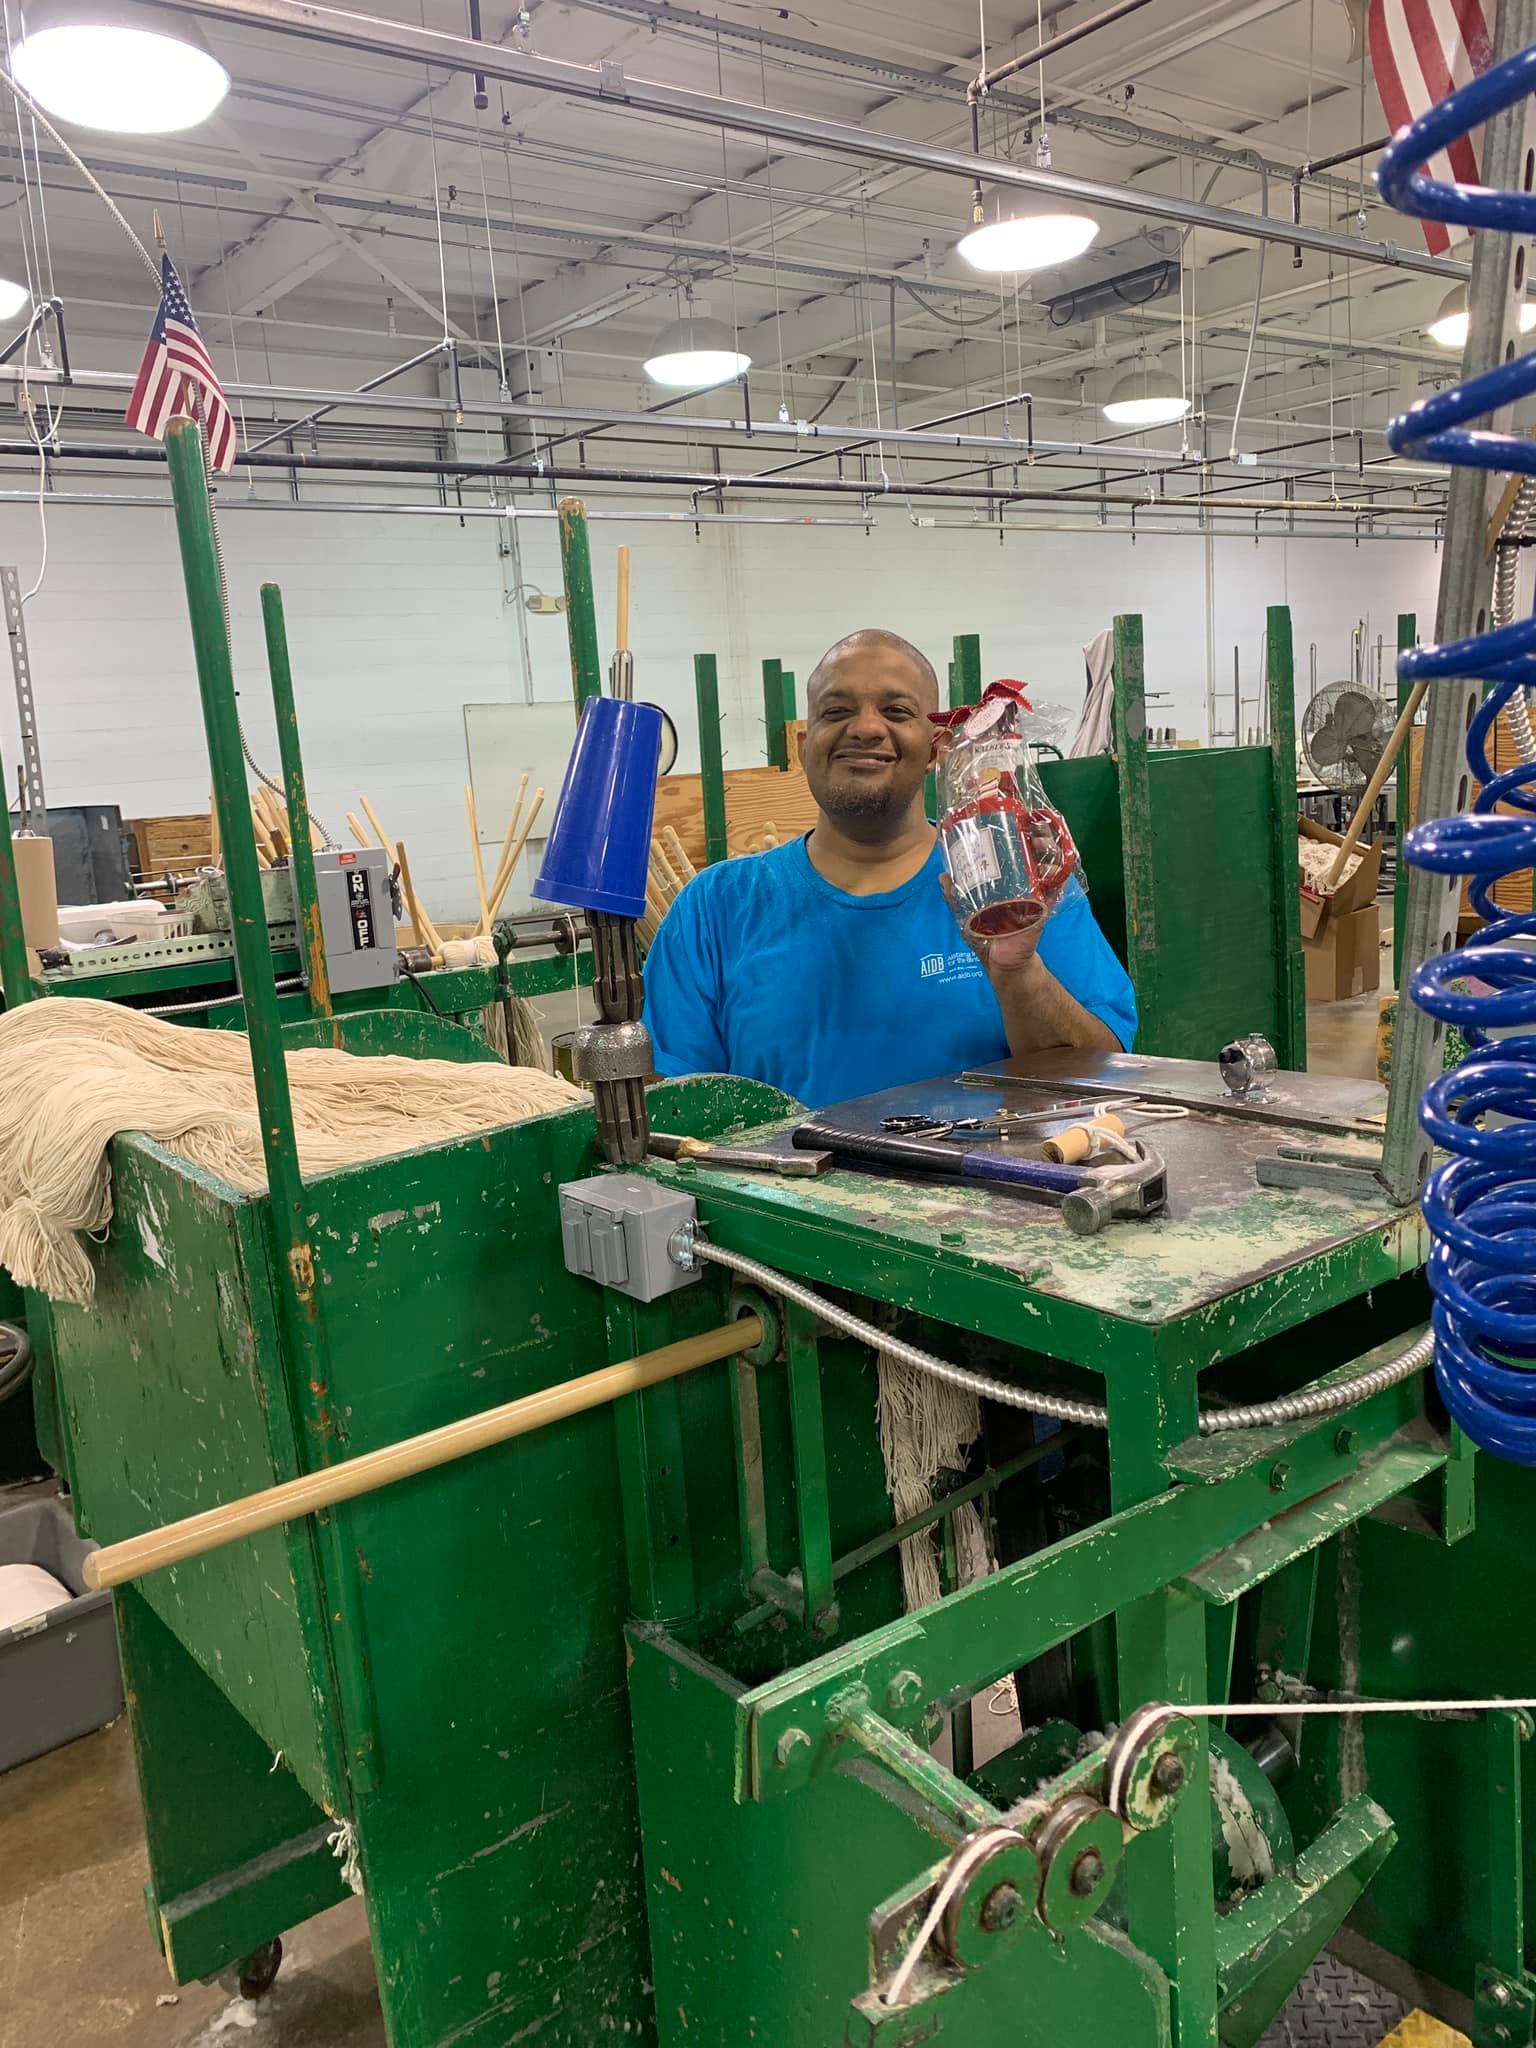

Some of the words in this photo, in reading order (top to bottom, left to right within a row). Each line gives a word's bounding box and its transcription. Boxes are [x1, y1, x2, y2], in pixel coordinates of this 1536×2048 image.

[352, 874, 364, 892] ON
[357, 919, 369, 946] OFF
[921, 957, 944, 975] AIDB
